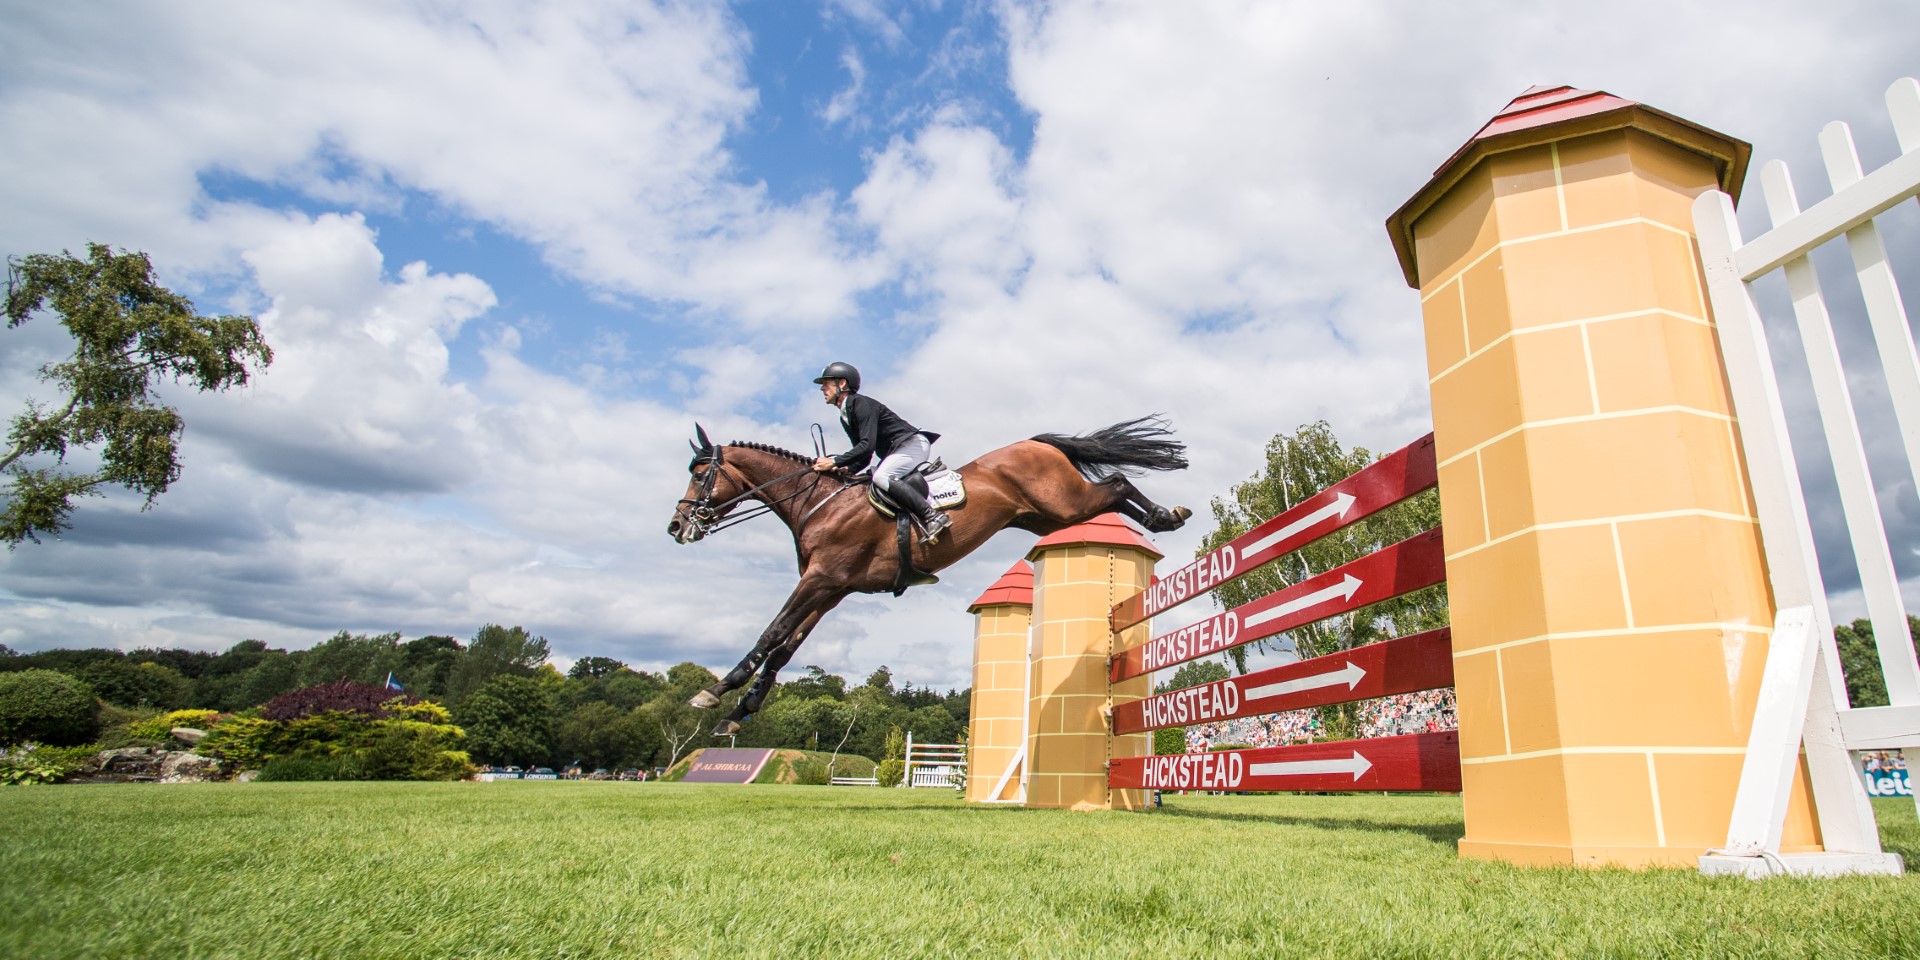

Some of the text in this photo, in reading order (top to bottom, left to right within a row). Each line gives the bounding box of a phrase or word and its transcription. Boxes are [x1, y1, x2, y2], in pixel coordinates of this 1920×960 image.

[933, 490, 958, 501] nolte
[1143, 545, 1236, 617] HICKSTEAD
[1142, 611, 1239, 671] HICKSTEAD
[1142, 680, 1239, 728] HICKSTEAD
[1142, 752, 1243, 788] HICKSTEAD
